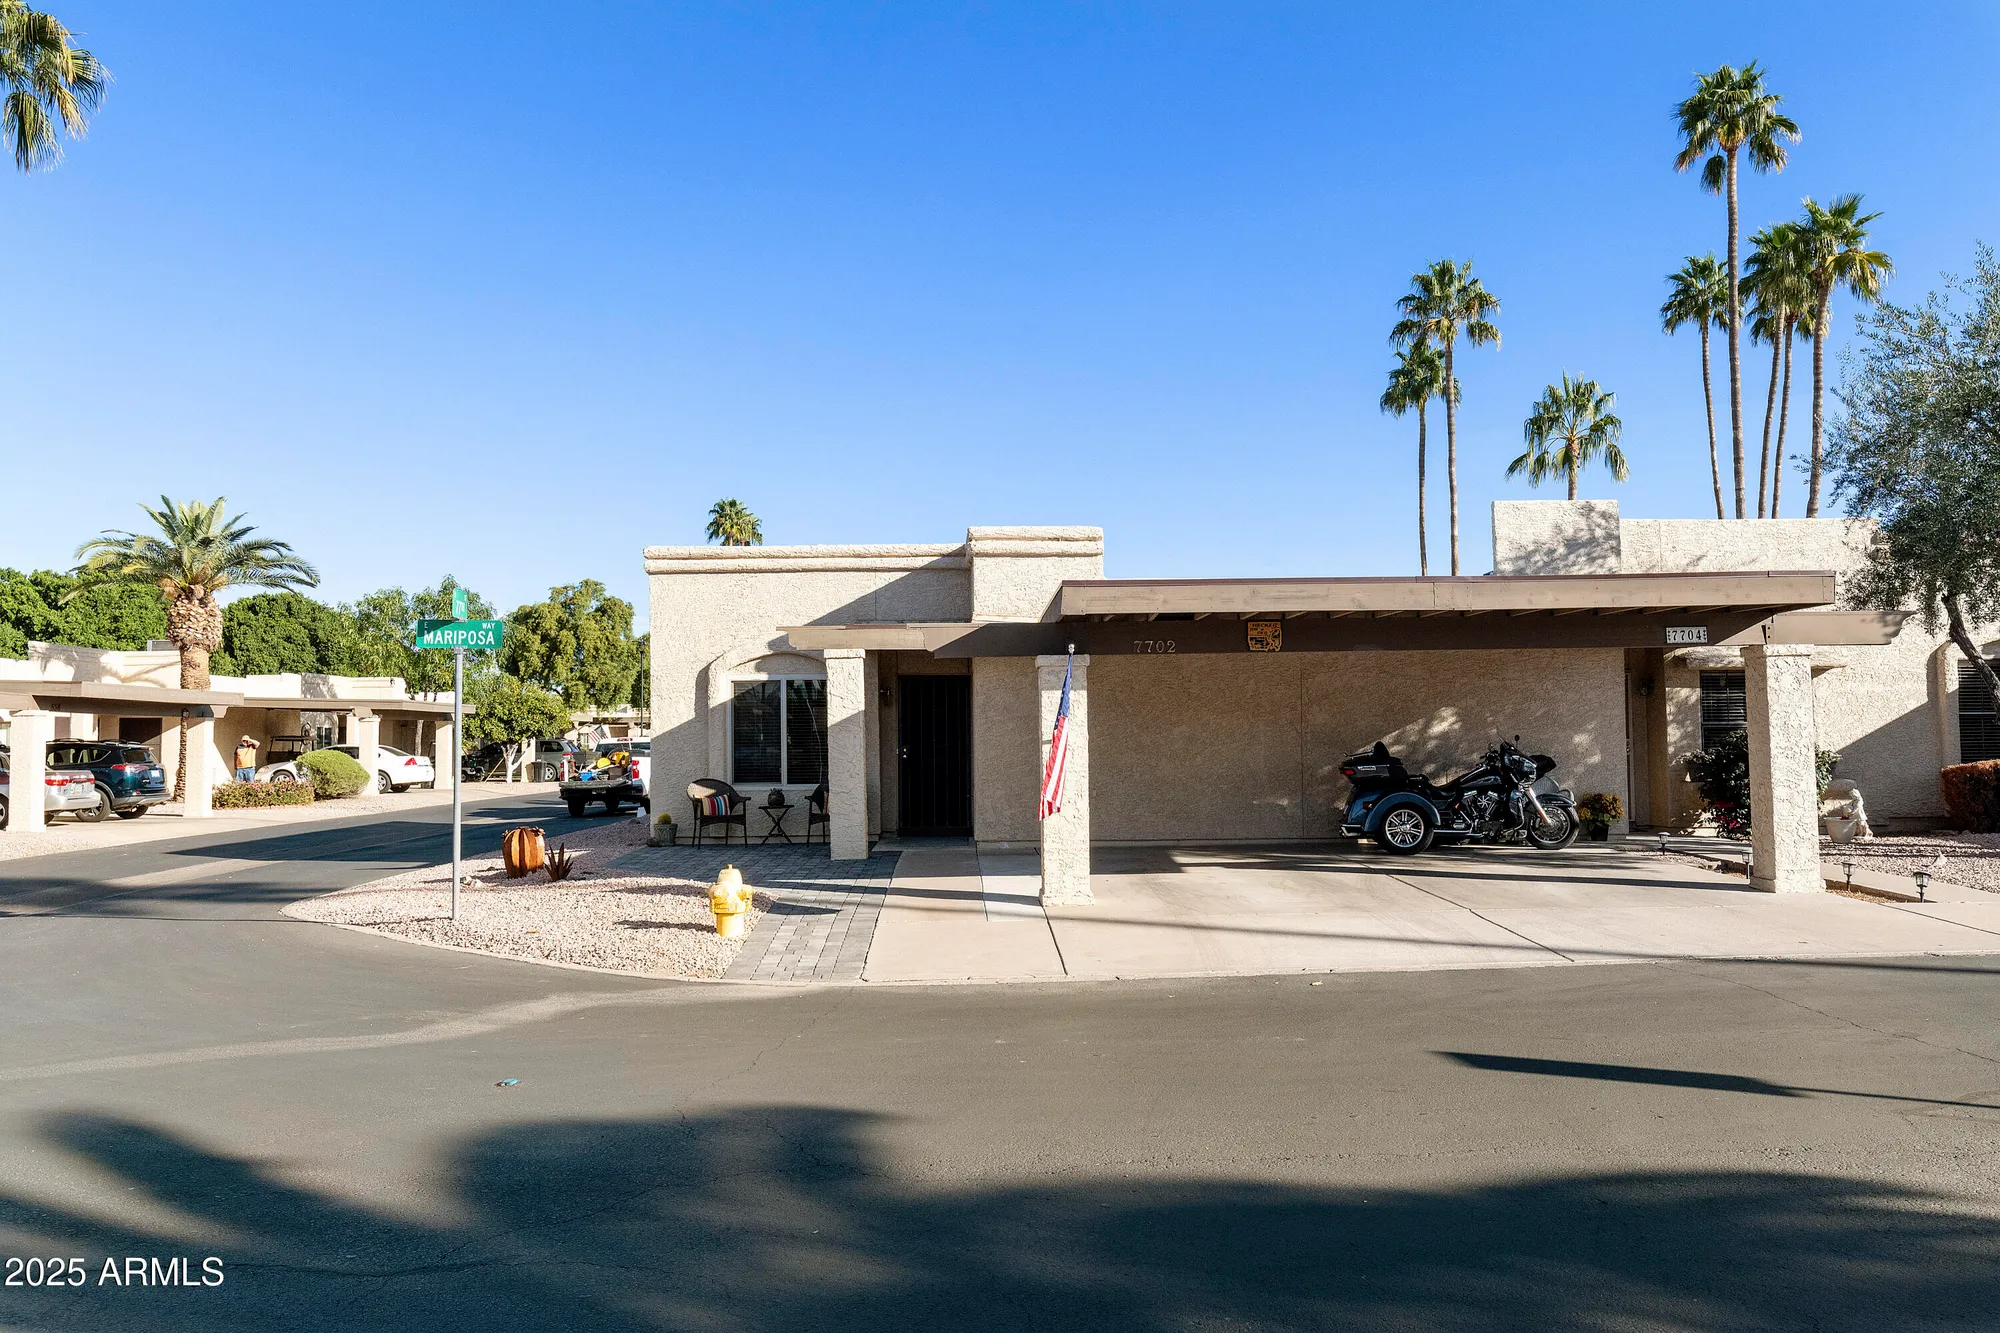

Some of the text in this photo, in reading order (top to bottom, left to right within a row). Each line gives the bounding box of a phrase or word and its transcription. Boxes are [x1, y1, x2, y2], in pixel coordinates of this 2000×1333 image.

[482, 622, 495, 630] WAY
[423, 630, 495, 645] MARIPOSA
[1672, 630, 1701, 641] 7704
[1133, 640, 1176, 653] 7702
